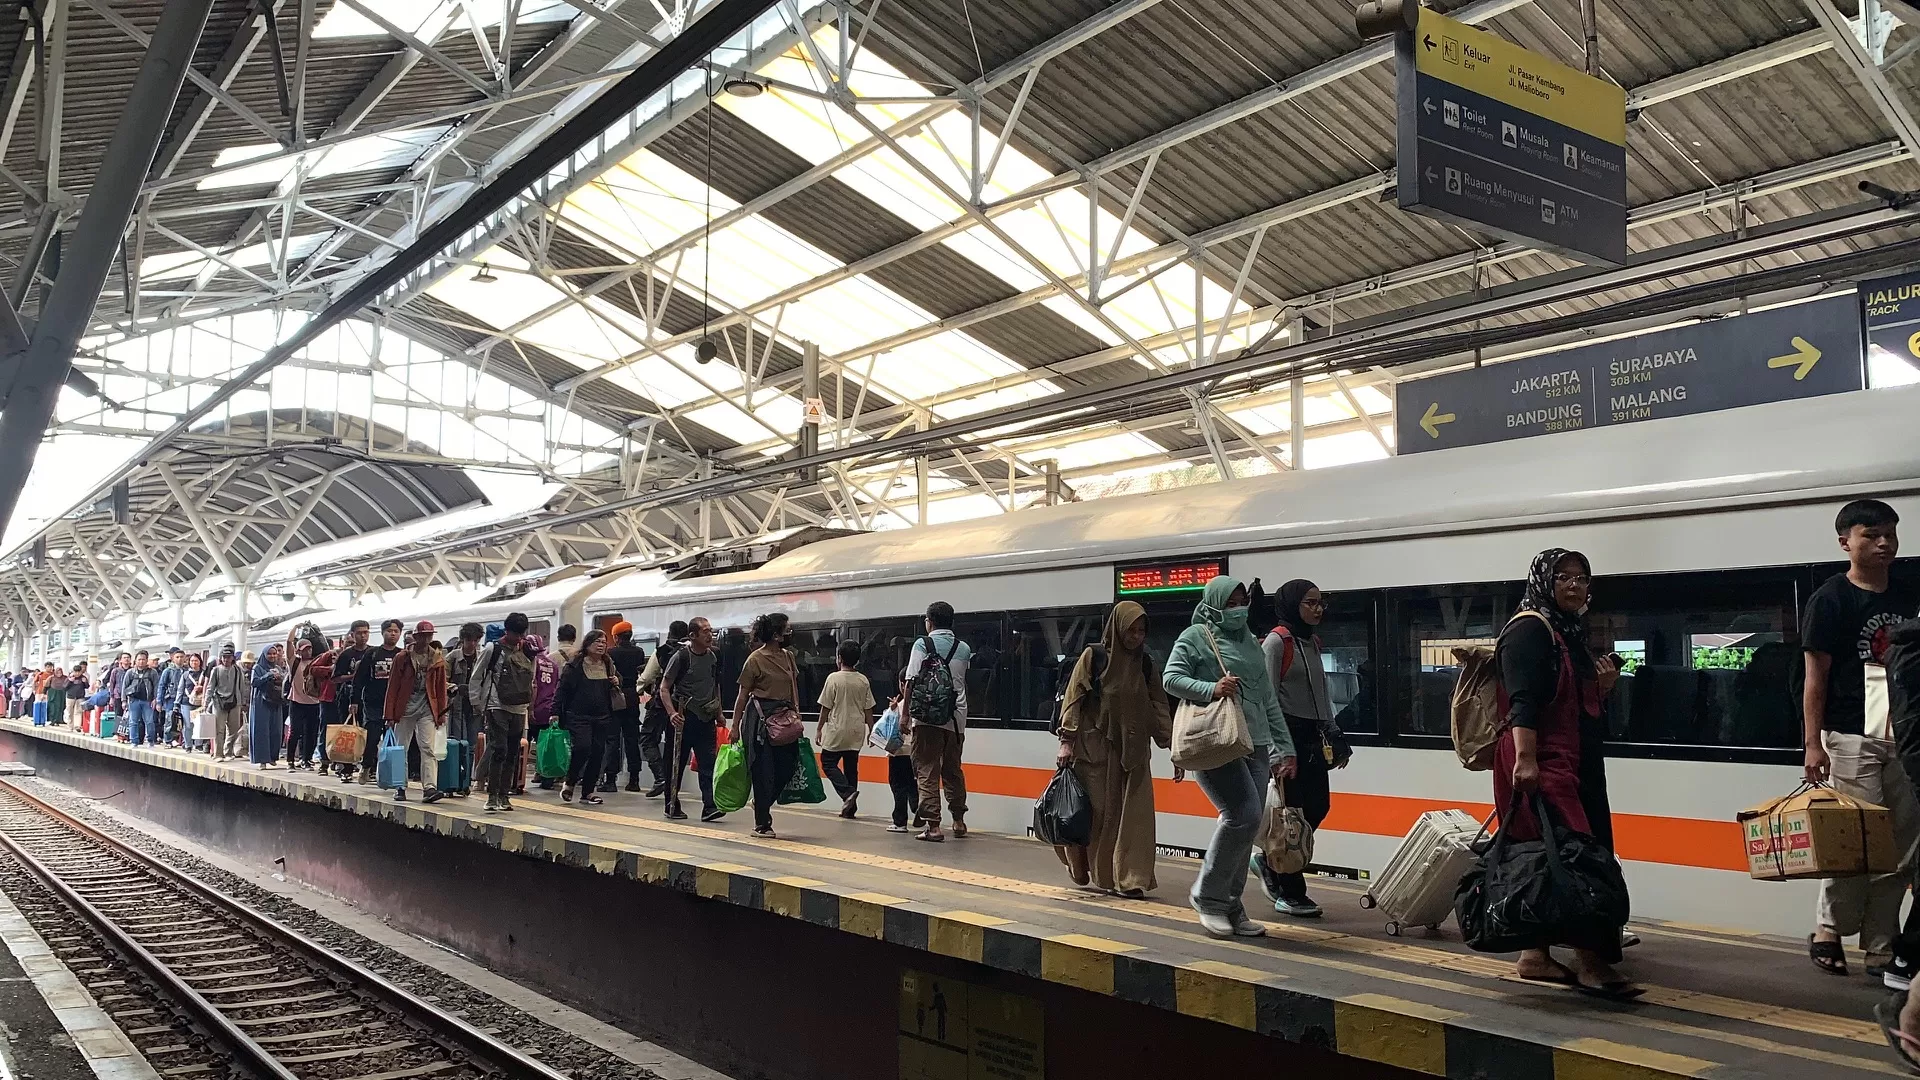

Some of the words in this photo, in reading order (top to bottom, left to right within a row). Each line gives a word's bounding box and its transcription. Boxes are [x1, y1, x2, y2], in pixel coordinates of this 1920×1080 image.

[1463, 43, 1491, 64] Keluar
[1464, 60, 1475, 71] Exit
[1508, 64, 1516, 75] Jl.
[1518, 67, 1535, 82] Pasar
[1508, 78, 1516, 88] Jl.
[1518, 80, 1550, 100] Malioboro
[1462, 105, 1487, 126] Toilet
[1463, 123, 1477, 134] Rest
[1477, 127, 1494, 141] Room
[1520, 127, 1549, 148] Musala
[1580, 149, 1620, 172] Keamanan
[1464, 172, 1492, 195] Ruang
[1493, 182, 1535, 206] Menyusui
[1560, 204, 1579, 220] ATM
[1867, 284, 1920, 307] JALUR
[1609, 348, 1697, 376] SURABAYA
[1511, 369, 1580, 394] JAKARTA
[1610, 376, 1630, 387] 308
[1632, 371, 1651, 383] KM
[1545, 389, 1562, 399] 512
[1563, 384, 1581, 396] KM
[1611, 386, 1687, 411] MALANG
[1507, 403, 1582, 428] BANDUNG
[1545, 421, 1563, 431] 388
[1565, 417, 1583, 429] KM
[1612, 412, 1630, 422] 391
[1632, 407, 1650, 419] KM
[541, 672, 552, 684] 86
